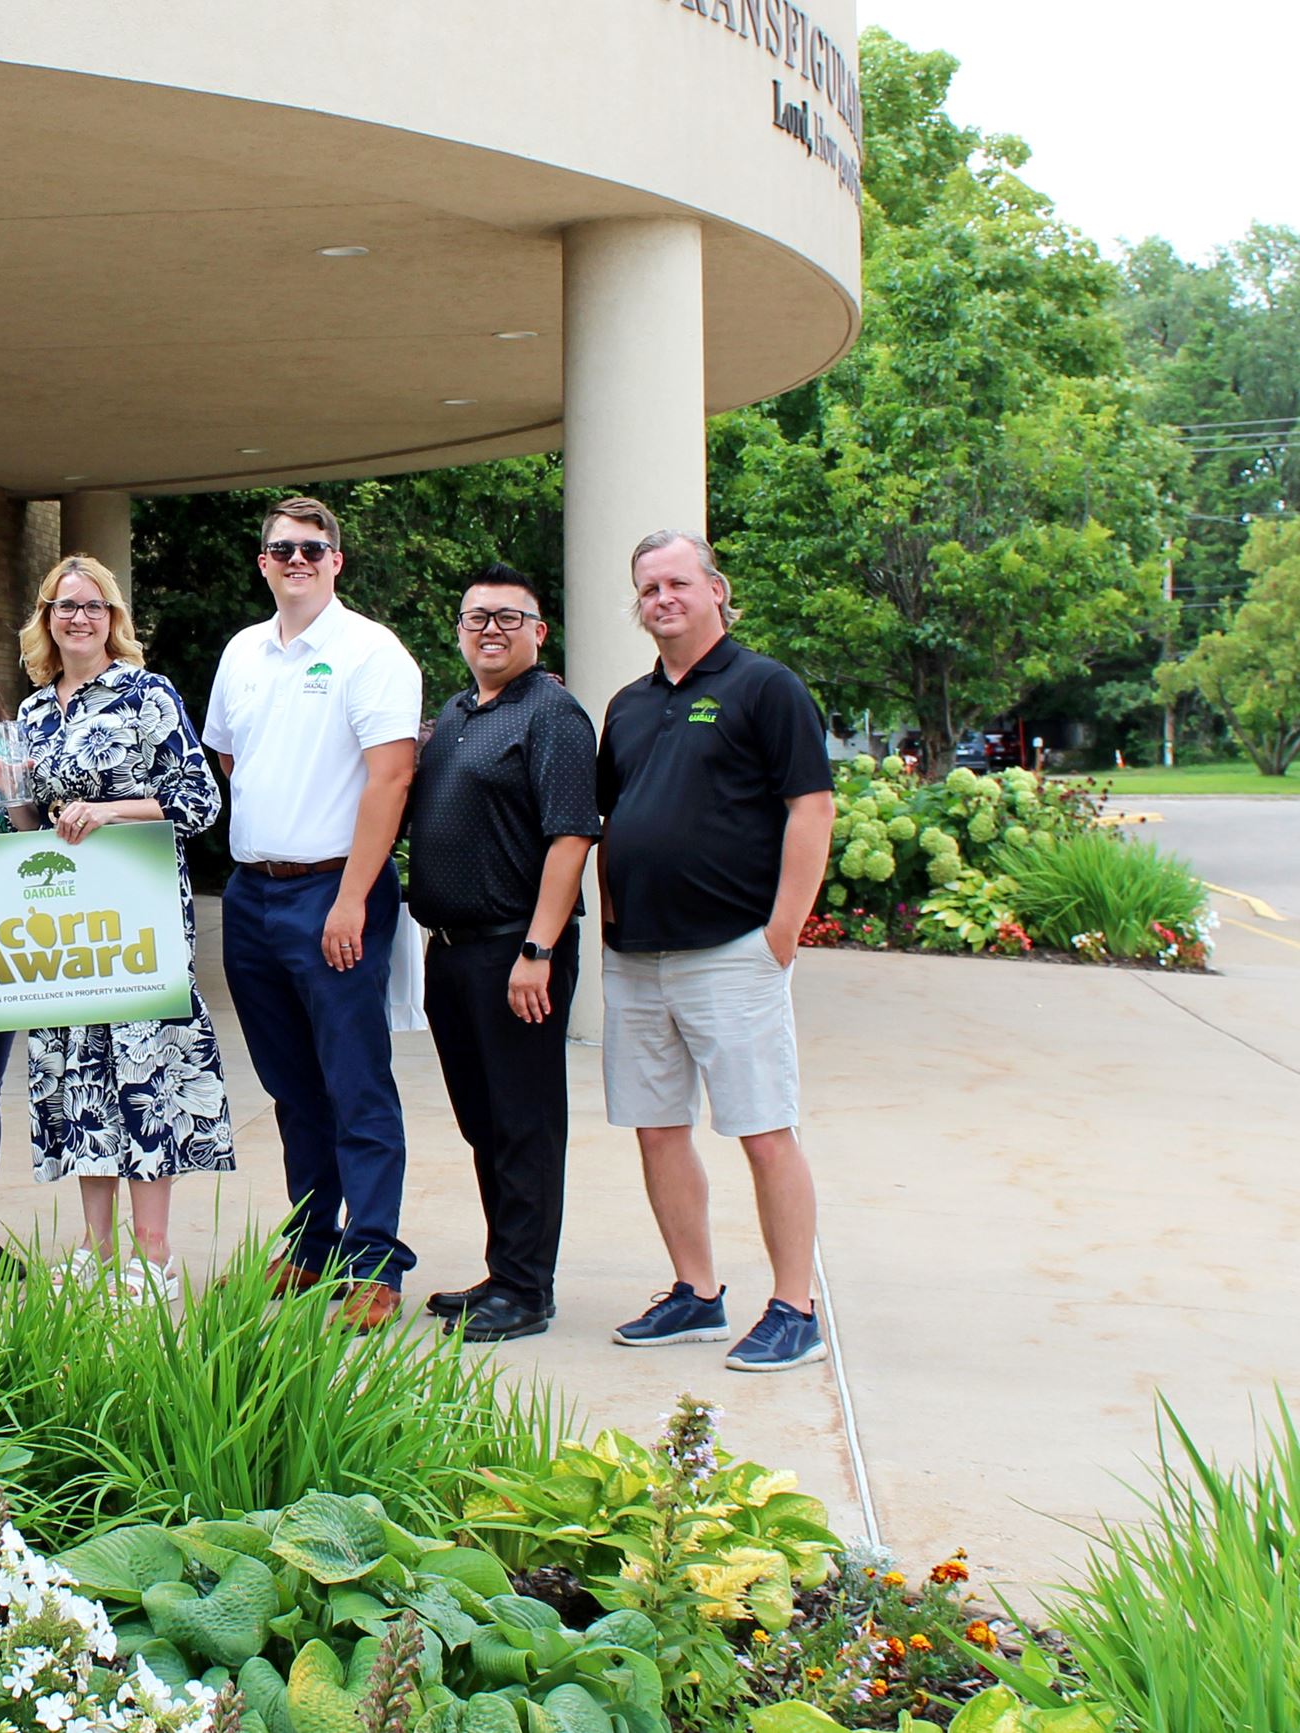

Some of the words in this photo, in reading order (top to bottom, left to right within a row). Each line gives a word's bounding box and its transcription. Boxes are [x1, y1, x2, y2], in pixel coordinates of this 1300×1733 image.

[23, 885, 76, 900] OAKDALE
[3, 995, 18, 1004] FOR
[20, 991, 63, 1001] EXCELLENCE
[65, 990, 73, 998] IN
[75, 987, 113, 997] PROPERTY
[115, 983, 167, 993] MAINTENANCE
